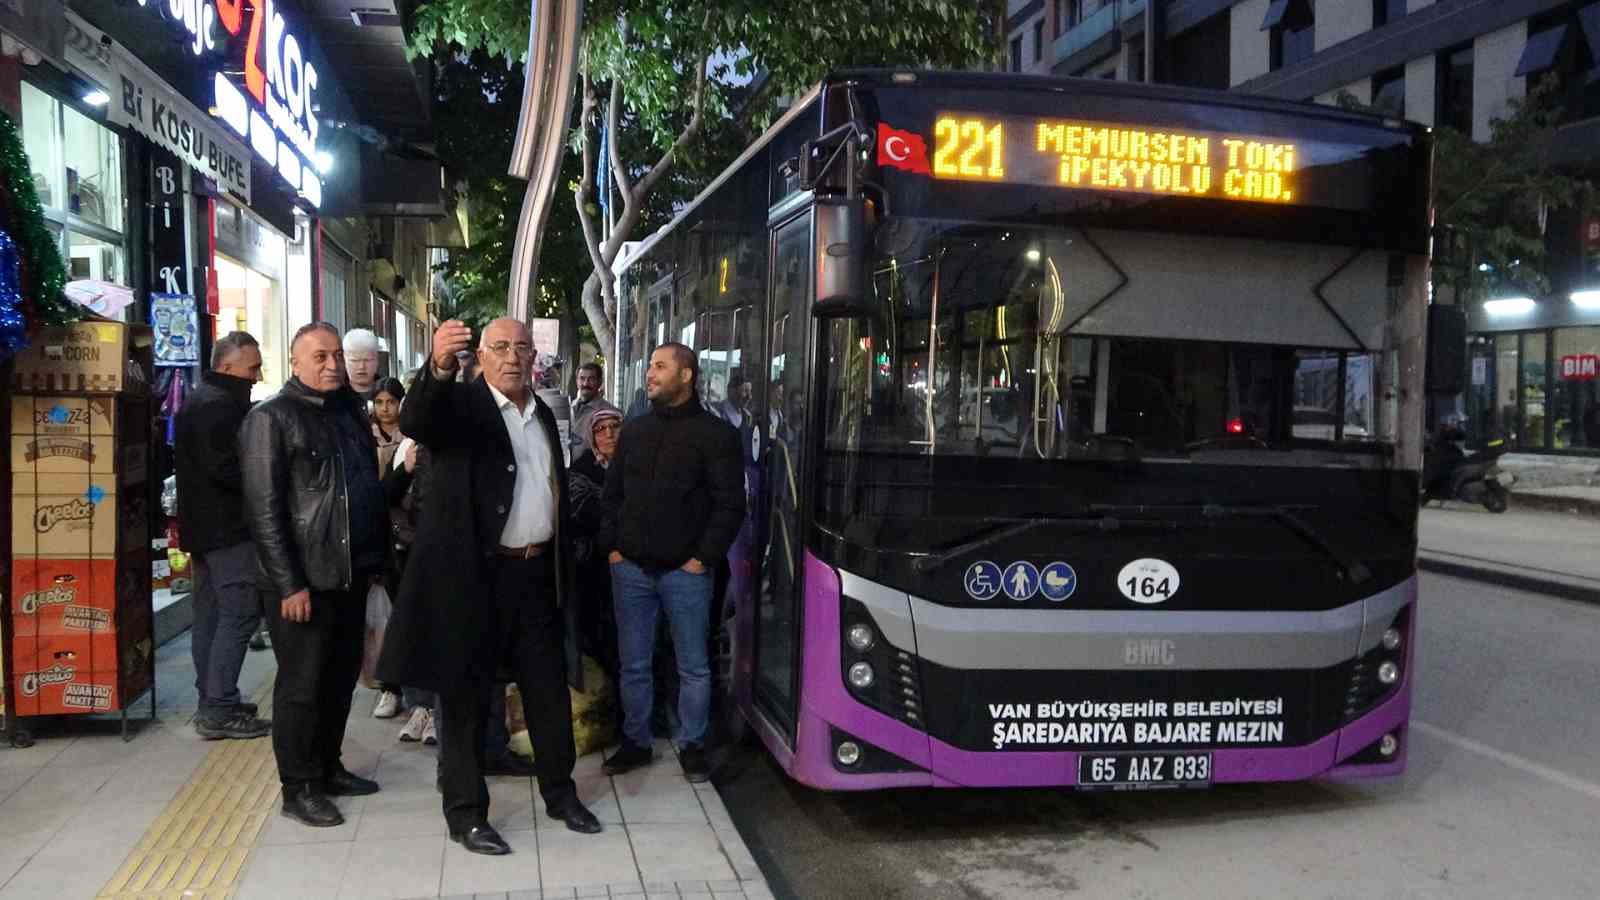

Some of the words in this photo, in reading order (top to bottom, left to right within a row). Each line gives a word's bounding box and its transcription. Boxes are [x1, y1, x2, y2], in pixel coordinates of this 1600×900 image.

[934, 116, 1004, 178] 221
[1037, 122, 1210, 165] MEMURSEN
[1223, 168, 1292, 201] CAD.
[41, 345, 100, 361] CORN
[1125, 576, 1171, 598] 164
[1124, 639, 1176, 666] BMC
[988, 703, 1031, 719] VAN
[1037, 699, 1168, 721] BÜYÜKŞEHİR
[1173, 697, 1283, 717] BELEDİYESİ
[992, 721, 1128, 750] ŞAREDARIYA
[1134, 721, 1211, 744] BAJARE
[1216, 721, 1284, 743] MEZIN
[1091, 757, 1116, 782] 65
[1127, 756, 1165, 781] AAZ
[1173, 755, 1208, 780] 833
